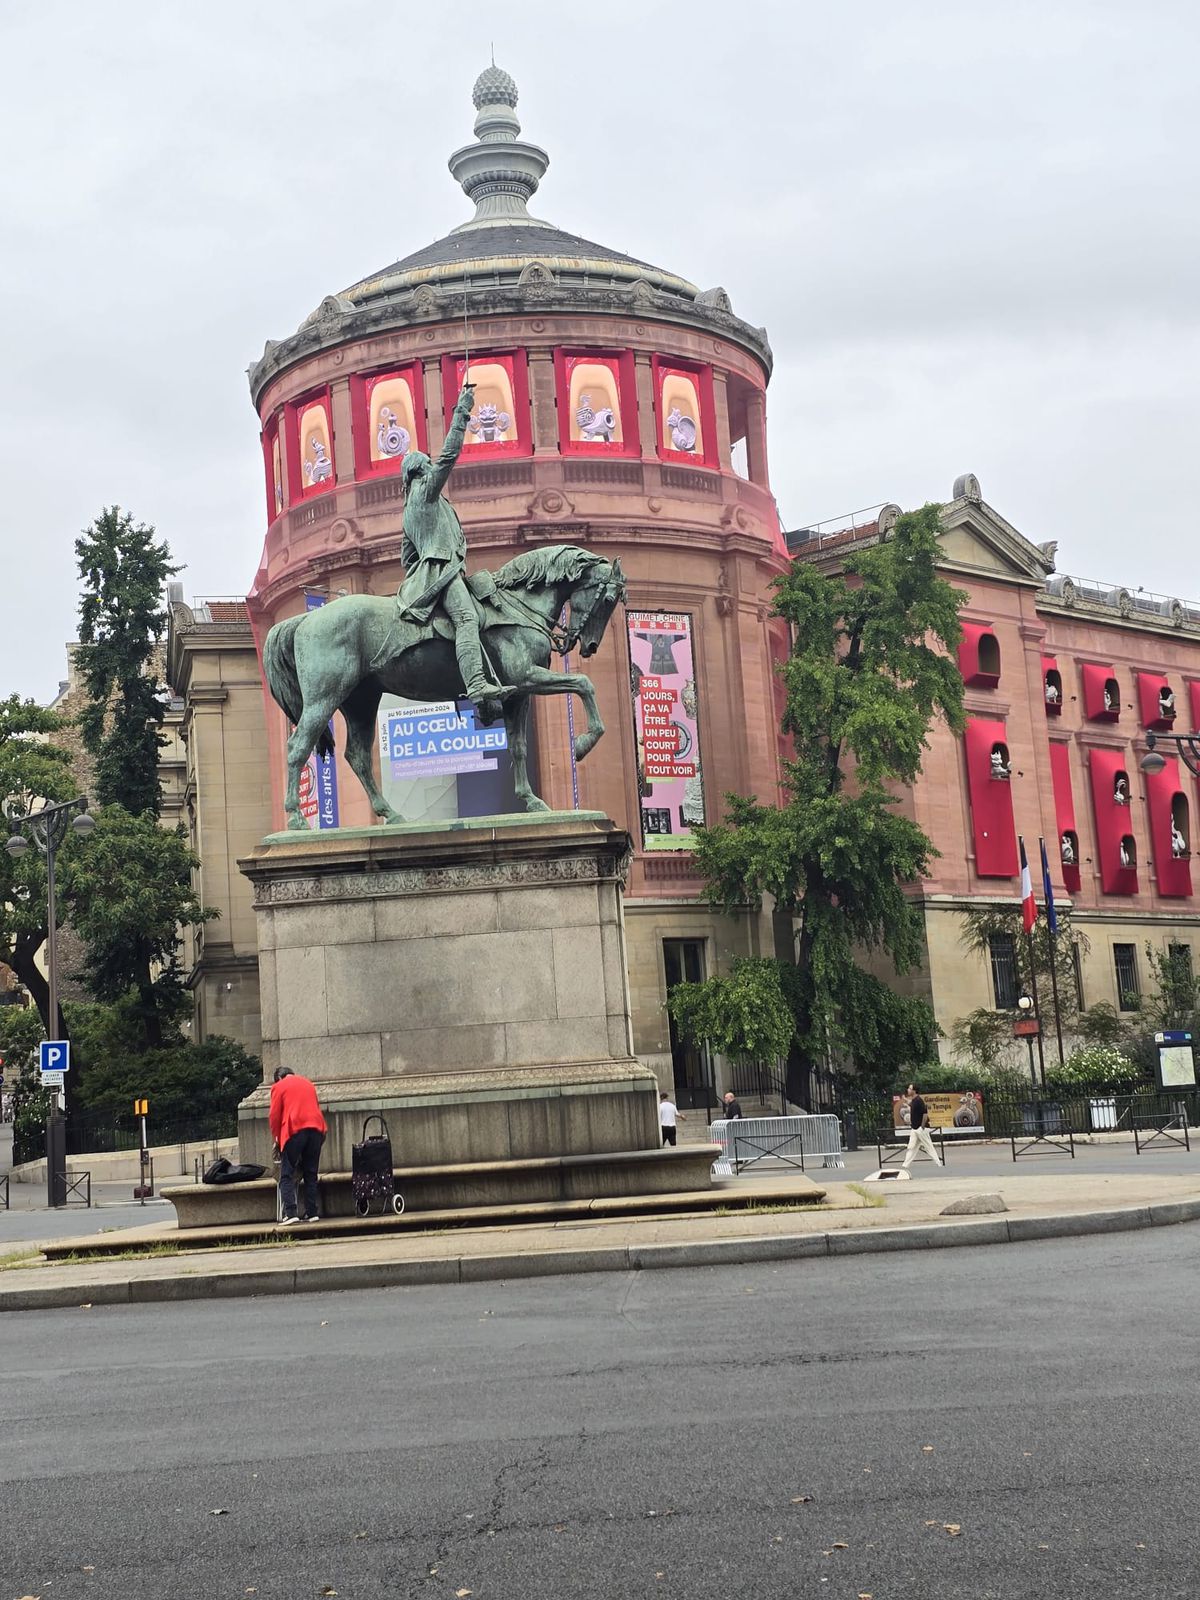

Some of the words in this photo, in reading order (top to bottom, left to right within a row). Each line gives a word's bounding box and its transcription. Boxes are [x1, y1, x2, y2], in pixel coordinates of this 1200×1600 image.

[642, 680, 658, 688] 366
[643, 692, 675, 701] JOURS,
[403, 707, 434, 716] septembre
[644, 704, 656, 714] ÇA
[645, 714, 666, 725] ÊTRE
[393, 724, 414, 737] AU
[418, 716, 468, 733] CŒUR
[394, 743, 413, 757] DE
[418, 741, 437, 755] LA
[441, 732, 506, 751] COULEU
[647, 753, 671, 762] POUR
[648, 766, 671, 774] TOUT
[322, 768, 332, 795] arts
[322, 798, 333, 825] des
[48, 1048, 61, 1066] P
